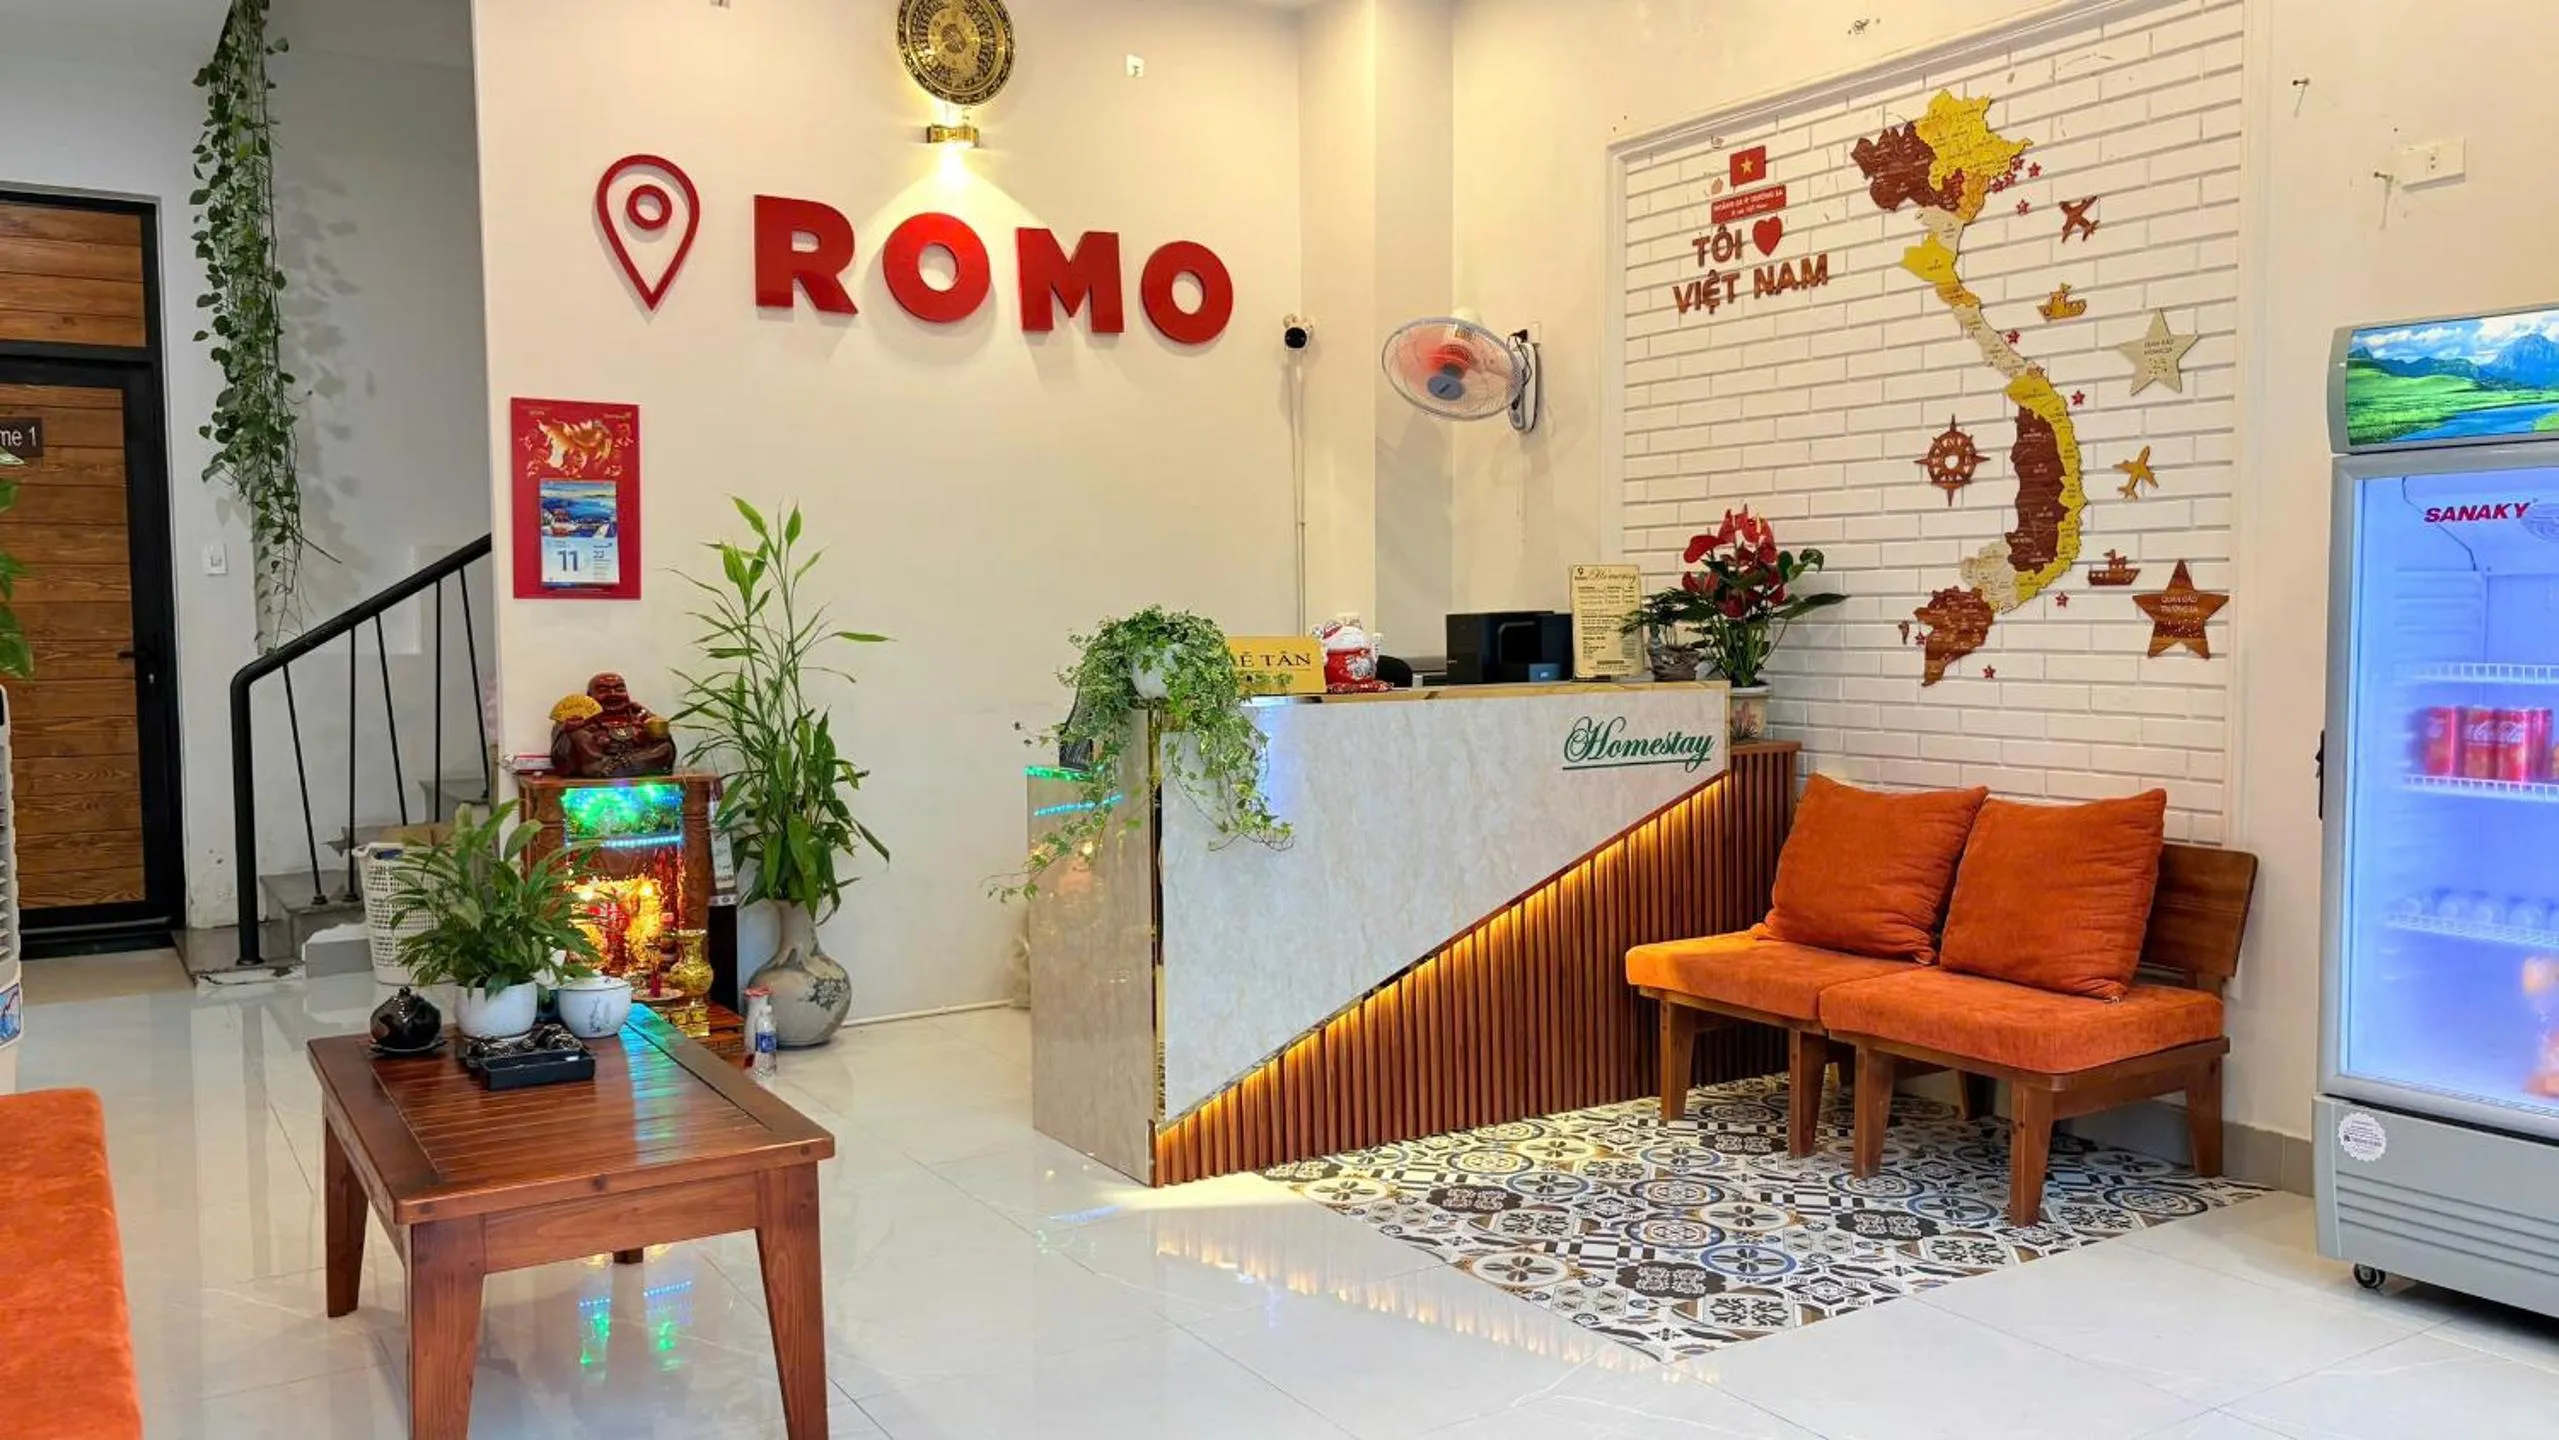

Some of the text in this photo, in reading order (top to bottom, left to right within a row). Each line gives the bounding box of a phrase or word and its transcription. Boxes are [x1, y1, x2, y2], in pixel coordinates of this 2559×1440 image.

[1692, 224, 1743, 267] TÔI
[754, 194, 1234, 344] ROMO
[1673, 253, 1828, 314] VIỆT NAM
[29, 426, 37, 447] 1
[2424, 502, 2531, 523] SANAKY
[557, 550, 578, 571] 11
[1260, 650, 1311, 667] TÂN
[1564, 716, 1715, 773] Homestay
